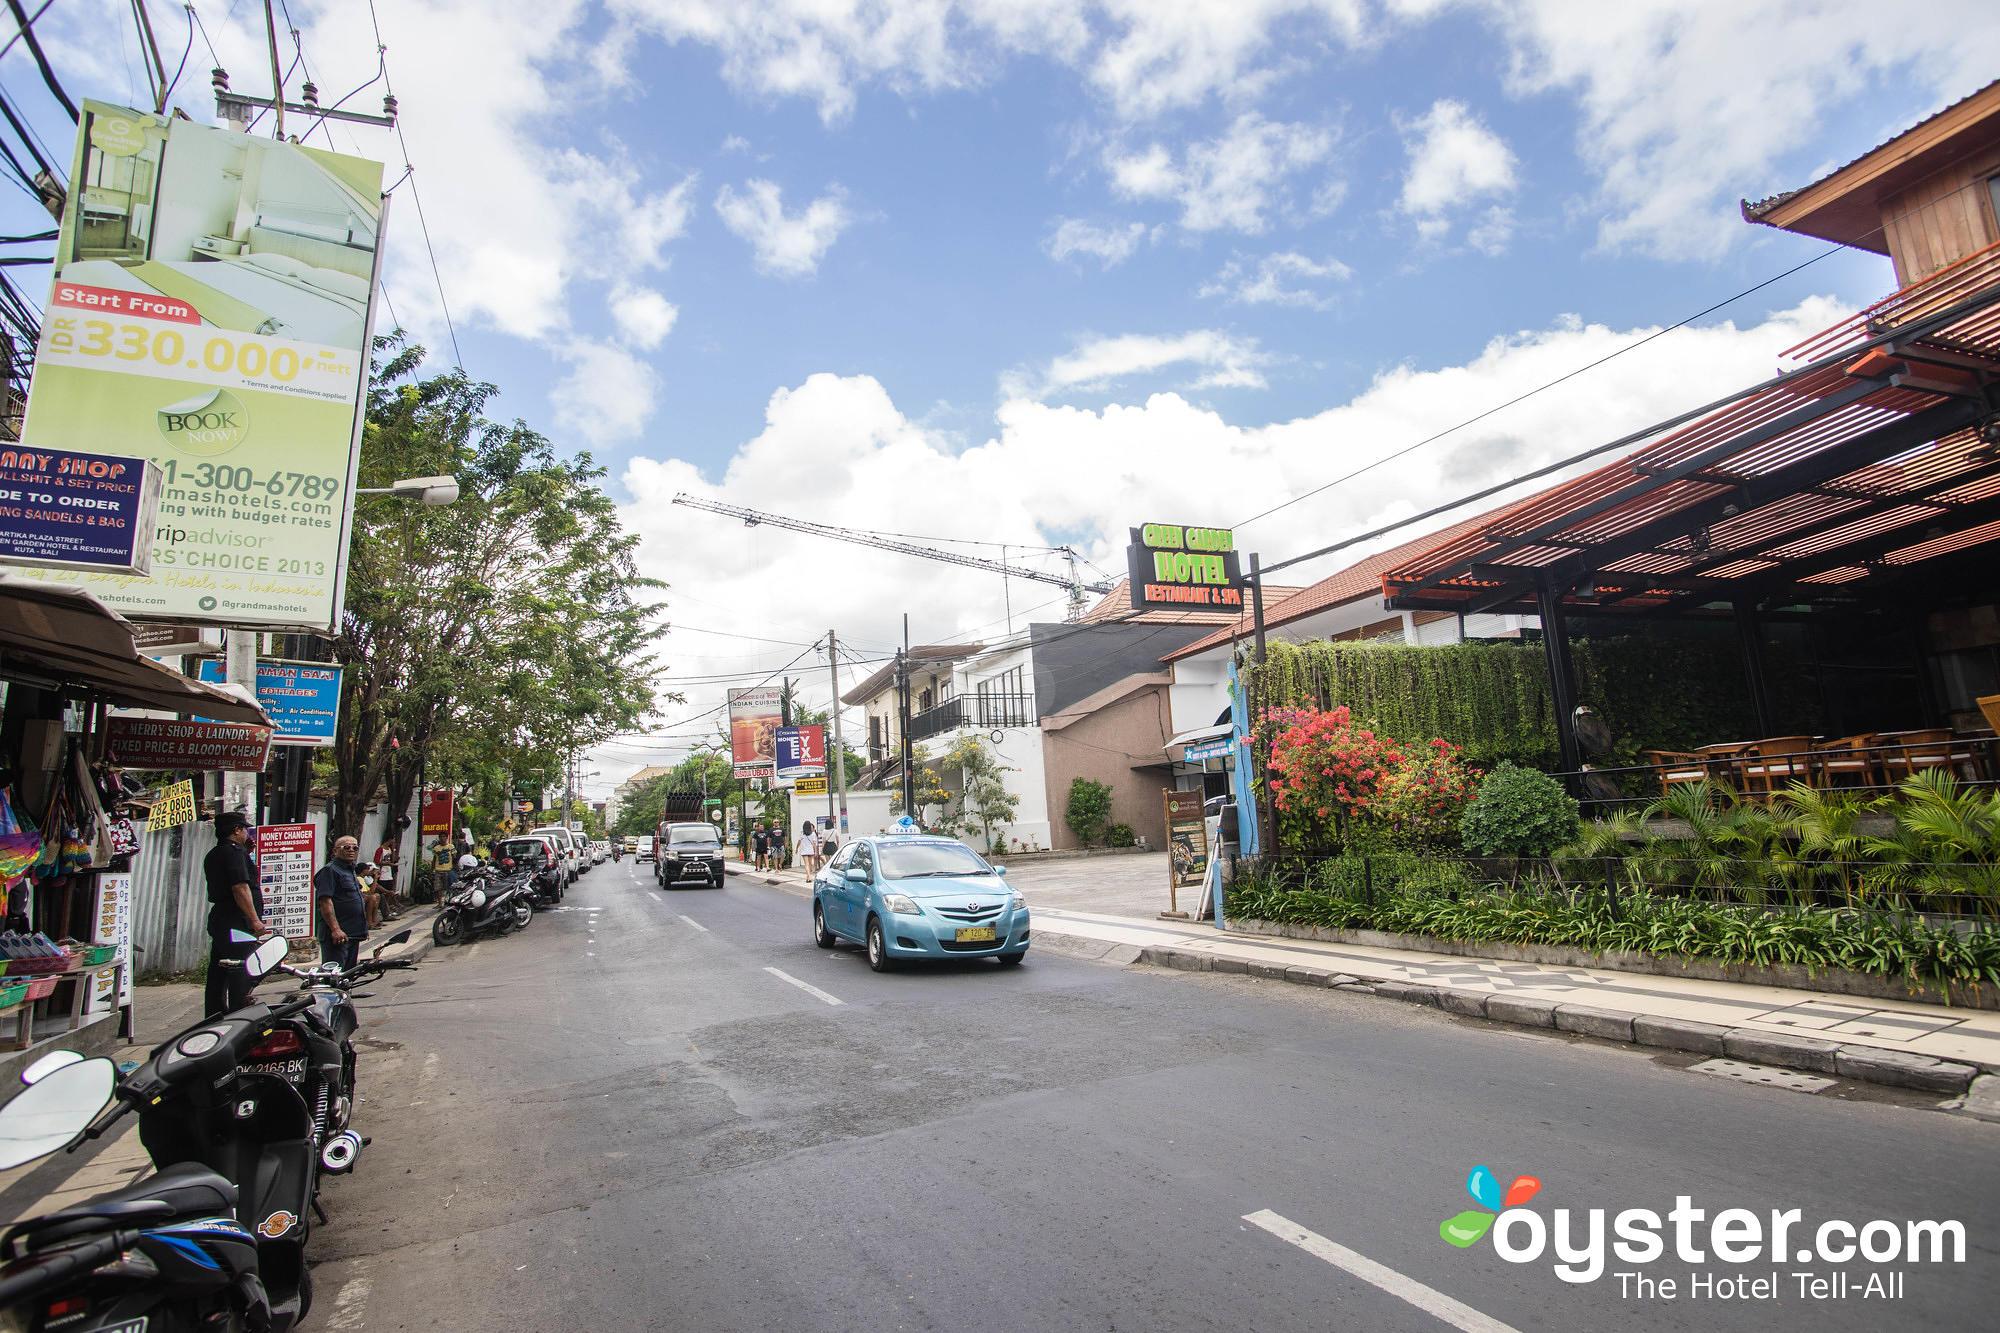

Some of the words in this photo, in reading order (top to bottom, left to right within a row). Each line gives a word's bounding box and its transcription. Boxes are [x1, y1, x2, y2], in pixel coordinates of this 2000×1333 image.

[59, 288, 121, 308] Start
[129, 297, 188, 318] From
[51, 318, 77, 355] IDR
[247, 380, 269, 389] Terms
[270, 383, 284, 391] and
[284, 386, 322, 397] Conditions
[322, 391, 347, 400] applied
[167, 411, 241, 432] BOOK
[188, 428, 238, 443] NOW!
[58, 458, 126, 479] SHOP
[55, 478, 64, 486] &
[67, 479, 94, 489] SET
[96, 481, 136, 493] PRICE
[152, 458, 339, 500] 1-300-6789
[28, 492, 53, 503] TO
[58, 496, 120, 511] ORDER
[25, 508, 83, 524] SANDELS
[86, 516, 95, 525] &
[98, 517, 125, 528] BAG
[191, 506, 226, 518] with
[231, 511, 287, 524] budget
[292, 516, 332, 528] rates
[13, 539, 45, 548] GARDEN
[46, 542, 71, 550] HOTEL
[80, 545, 128, 555] RESTAURANT
[29, 533, 54, 541] PLAZA
[55, 536, 84, 544] STREET
[1143, 524, 1184, 549] GREEN
[1186, 527, 1232, 552] GARDEN
[41, 548, 59, 556] BALI
[278, 559, 325, 576] 2013
[1153, 551, 1230, 585] HOTEL
[1145, 584, 1210, 603] RESTAURANT
[1213, 587, 1221, 604] &
[1221, 588, 1241, 605] SPA
[222, 600, 307, 613] @grandmashotels
[258, 687, 318, 697] COTTAGES
[299, 709, 334, 717] Conditioning
[128, 723, 165, 736] MERRY
[167, 725, 194, 738] SHOP
[196, 727, 204, 737] &
[206, 727, 252, 741] LAUNDRY
[112, 739, 141, 751] FIXED
[144, 740, 175, 753] PRICE
[178, 743, 186, 753] &
[188, 743, 229, 755] BLOODY
[230, 745, 262, 758] CHEAP
[151, 802, 167, 818] 782
[170, 795, 191, 812] 0808
[149, 815, 166, 831] 785
[169, 809, 193, 826] 6008
[261, 832, 283, 841] MONEY
[284, 830, 313, 840] CHANGER
[273, 839, 309, 847] COMMISSION
[101, 879, 117, 937] JENNY
[273, 906, 285, 915] EURO
[287, 1059, 304, 1073] BK
